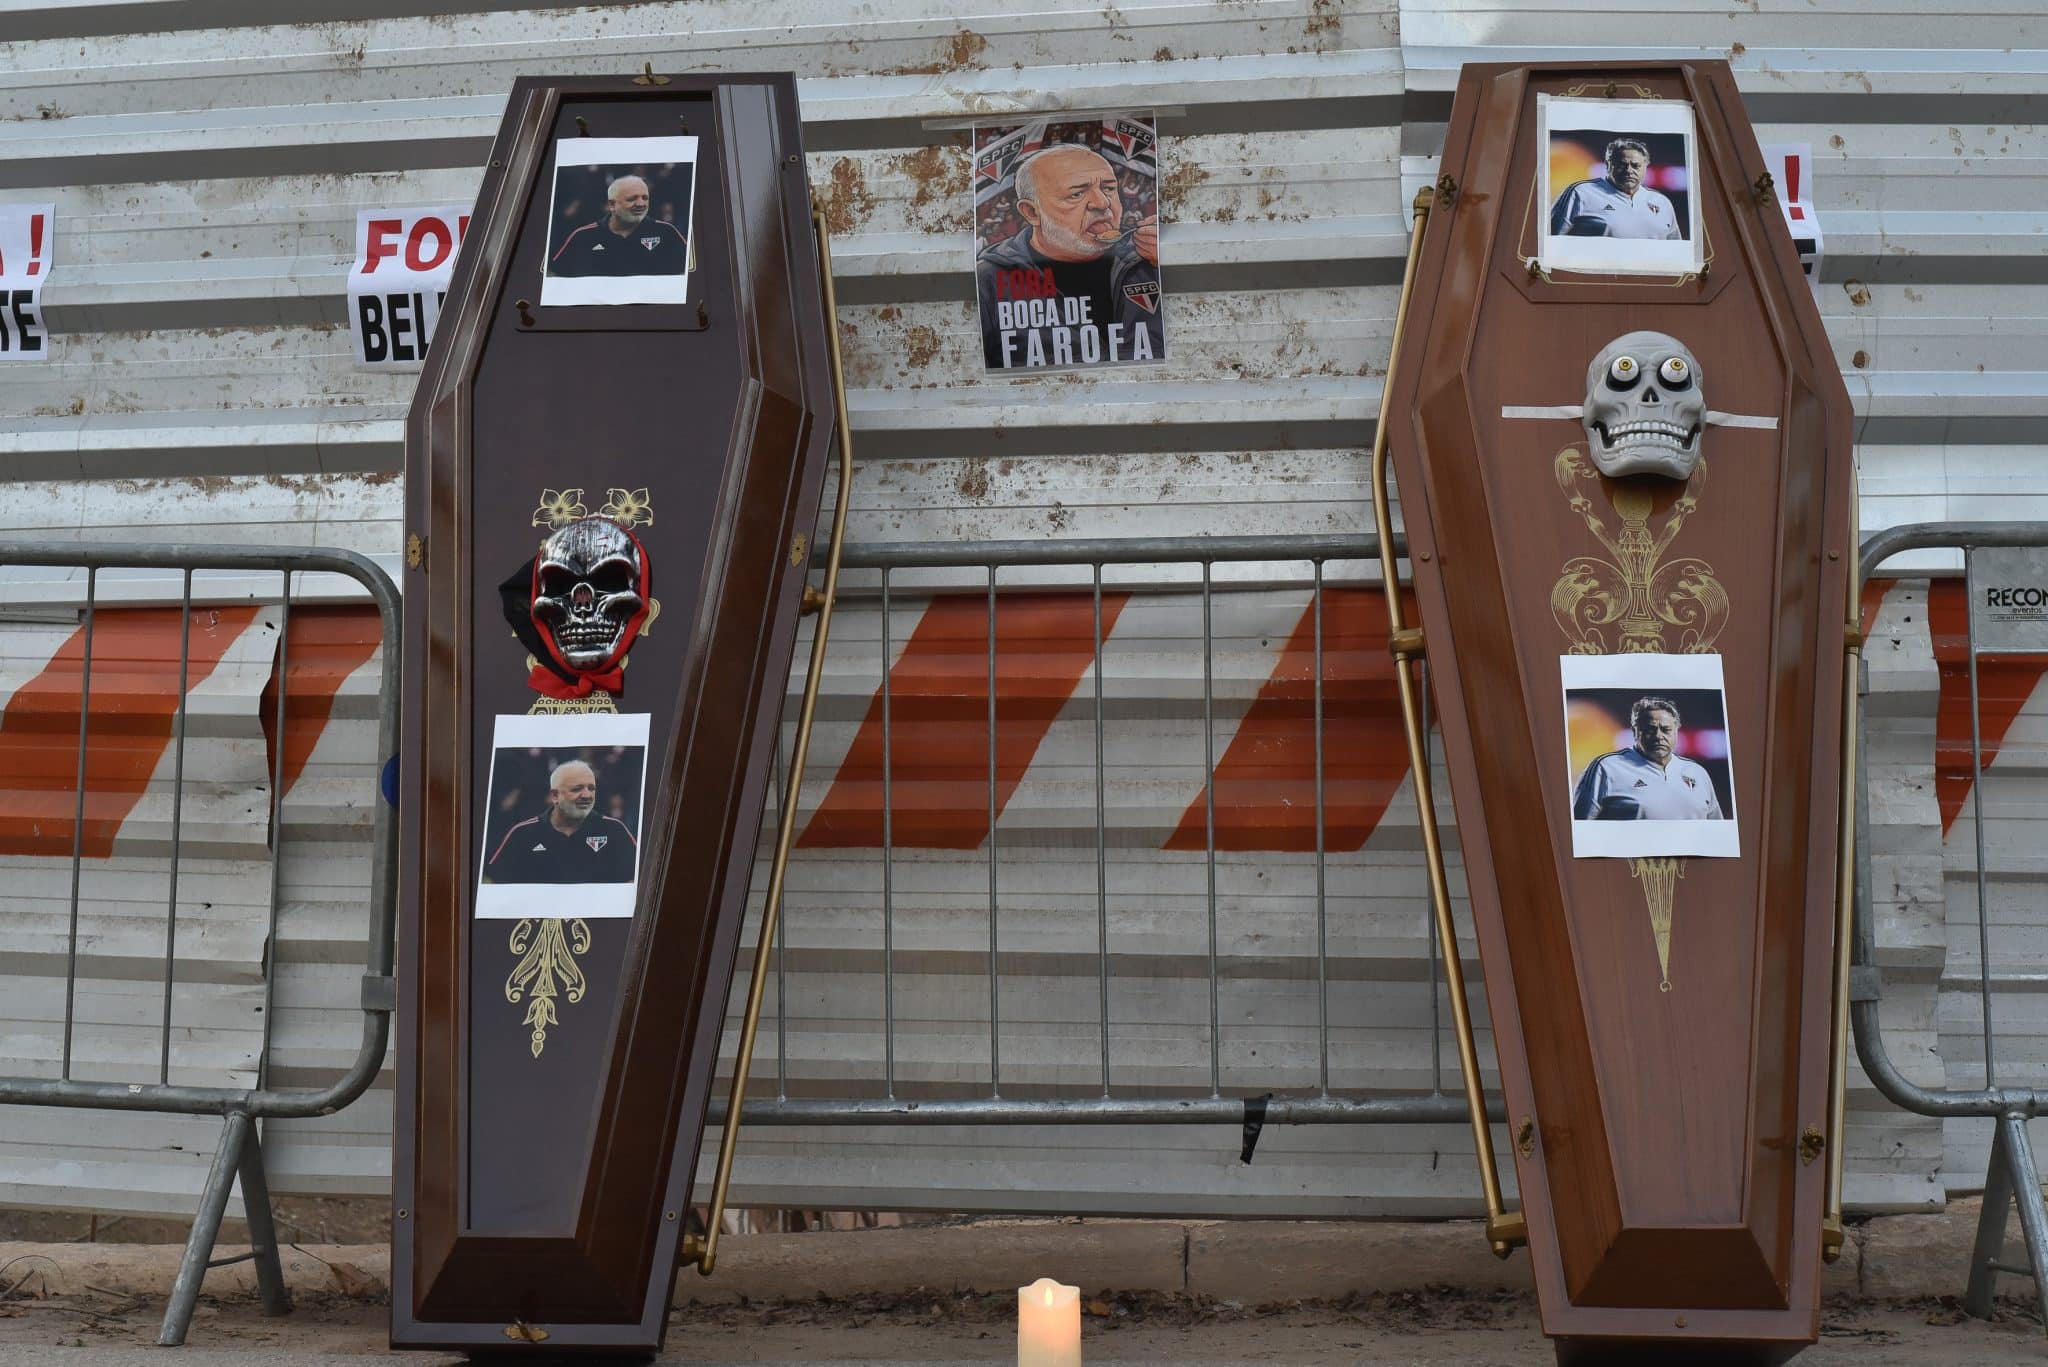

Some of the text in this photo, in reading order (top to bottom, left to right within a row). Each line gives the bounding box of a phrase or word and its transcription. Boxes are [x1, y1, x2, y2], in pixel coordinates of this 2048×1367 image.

[1120, 123, 1151, 143] SPFC
[982, 140, 1020, 166] SPFC
[996, 266, 1057, 300] FORA
[1126, 284, 1156, 294] SPFC
[358, 291, 447, 362] BEL
[997, 295, 1093, 330] BOCA DE
[1000, 321, 1154, 369] FAROFA
